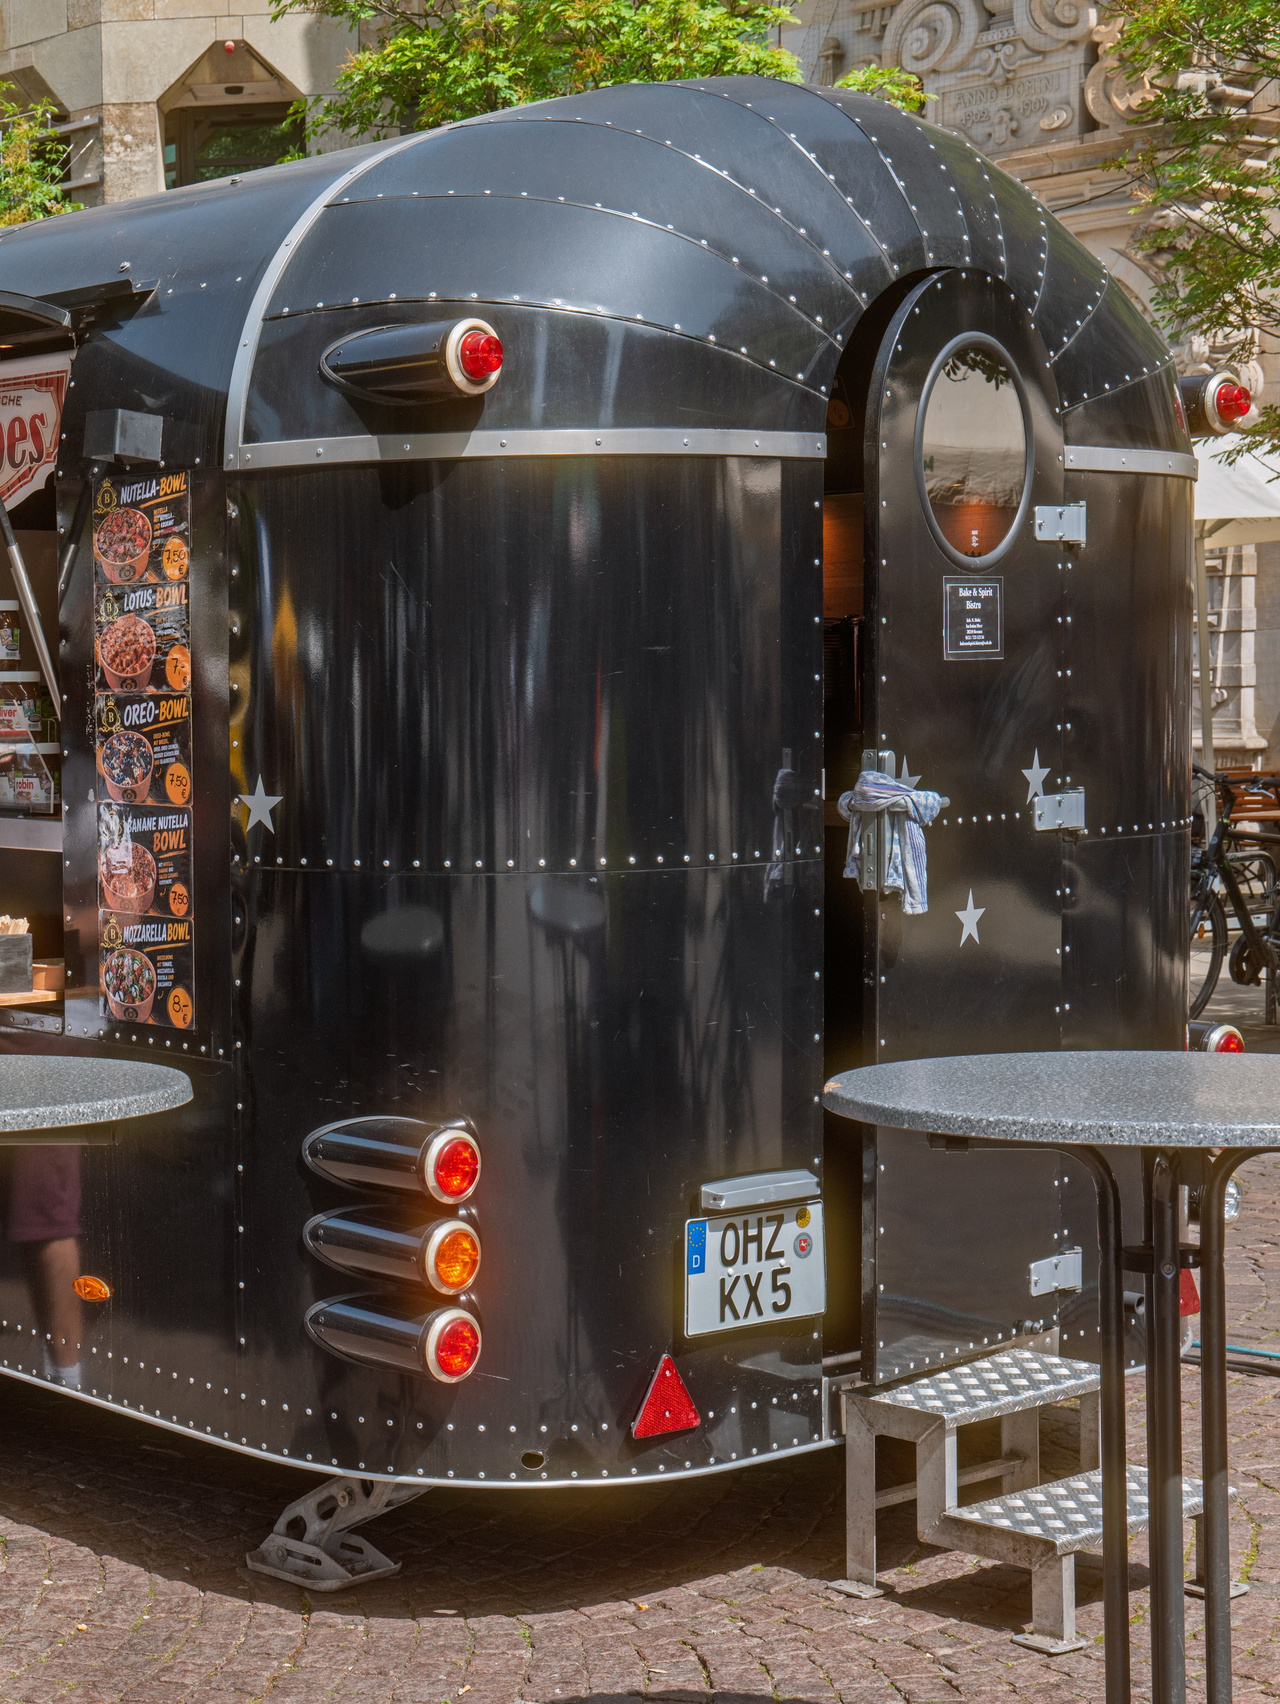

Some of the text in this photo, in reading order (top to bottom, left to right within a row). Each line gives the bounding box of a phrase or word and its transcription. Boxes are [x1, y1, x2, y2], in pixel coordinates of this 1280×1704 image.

[955, 73, 1060, 109] ANNO DOMINI
[1018, 97, 1049, 117] 1904
[961, 109, 990, 128] 1902
[120, 472, 187, 505] NUTELLA-BOWL
[124, 585, 188, 612] LOTUS-BOWL
[959, 587, 993, 599] Bake & Spirit
[966, 600, 981, 609] Bistro
[124, 697, 189, 726] OREO-BOWL
[15, 778, 34, 790] robin
[127, 814, 188, 833] BANANE NUTELLA
[153, 829, 186, 852] BOWL
[123, 922, 190, 943] MOZZARELLA BOWL
[720, 1213, 785, 1267] OHZ
[692, 1255, 701, 1268] D
[720, 1266, 792, 1323] KX 5
